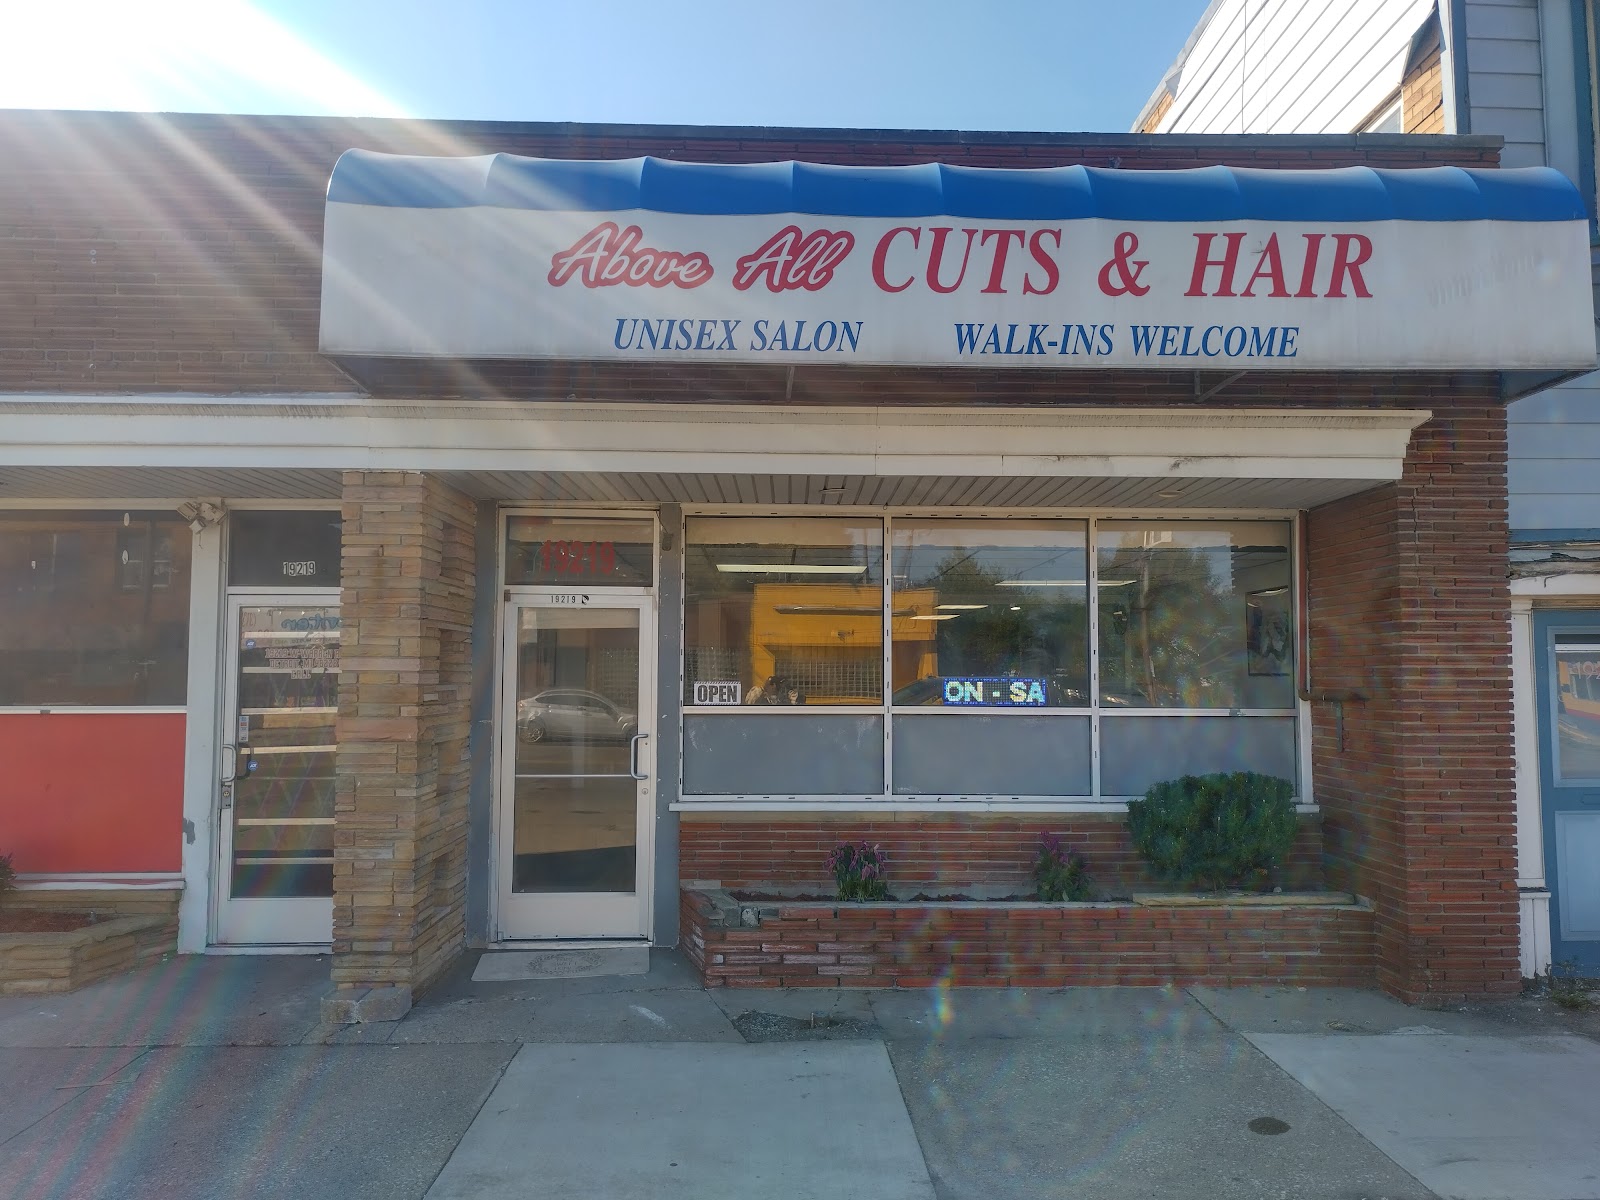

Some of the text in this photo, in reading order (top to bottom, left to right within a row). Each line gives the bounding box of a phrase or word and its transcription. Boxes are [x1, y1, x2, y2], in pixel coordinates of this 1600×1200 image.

[548, 221, 1373, 298] Above All CUTS & HAIR
[613, 318, 864, 352] UNISEX SALON
[953, 322, 1300, 358] WALK-INS WELCOME
[283, 561, 316, 576] 19219
[540, 540, 616, 575] 19219
[550, 595, 576, 604] 19219
[697, 684, 738, 703] OPEN
[944, 681, 983, 702] ON
[1010, 681, 1046, 702] SA
